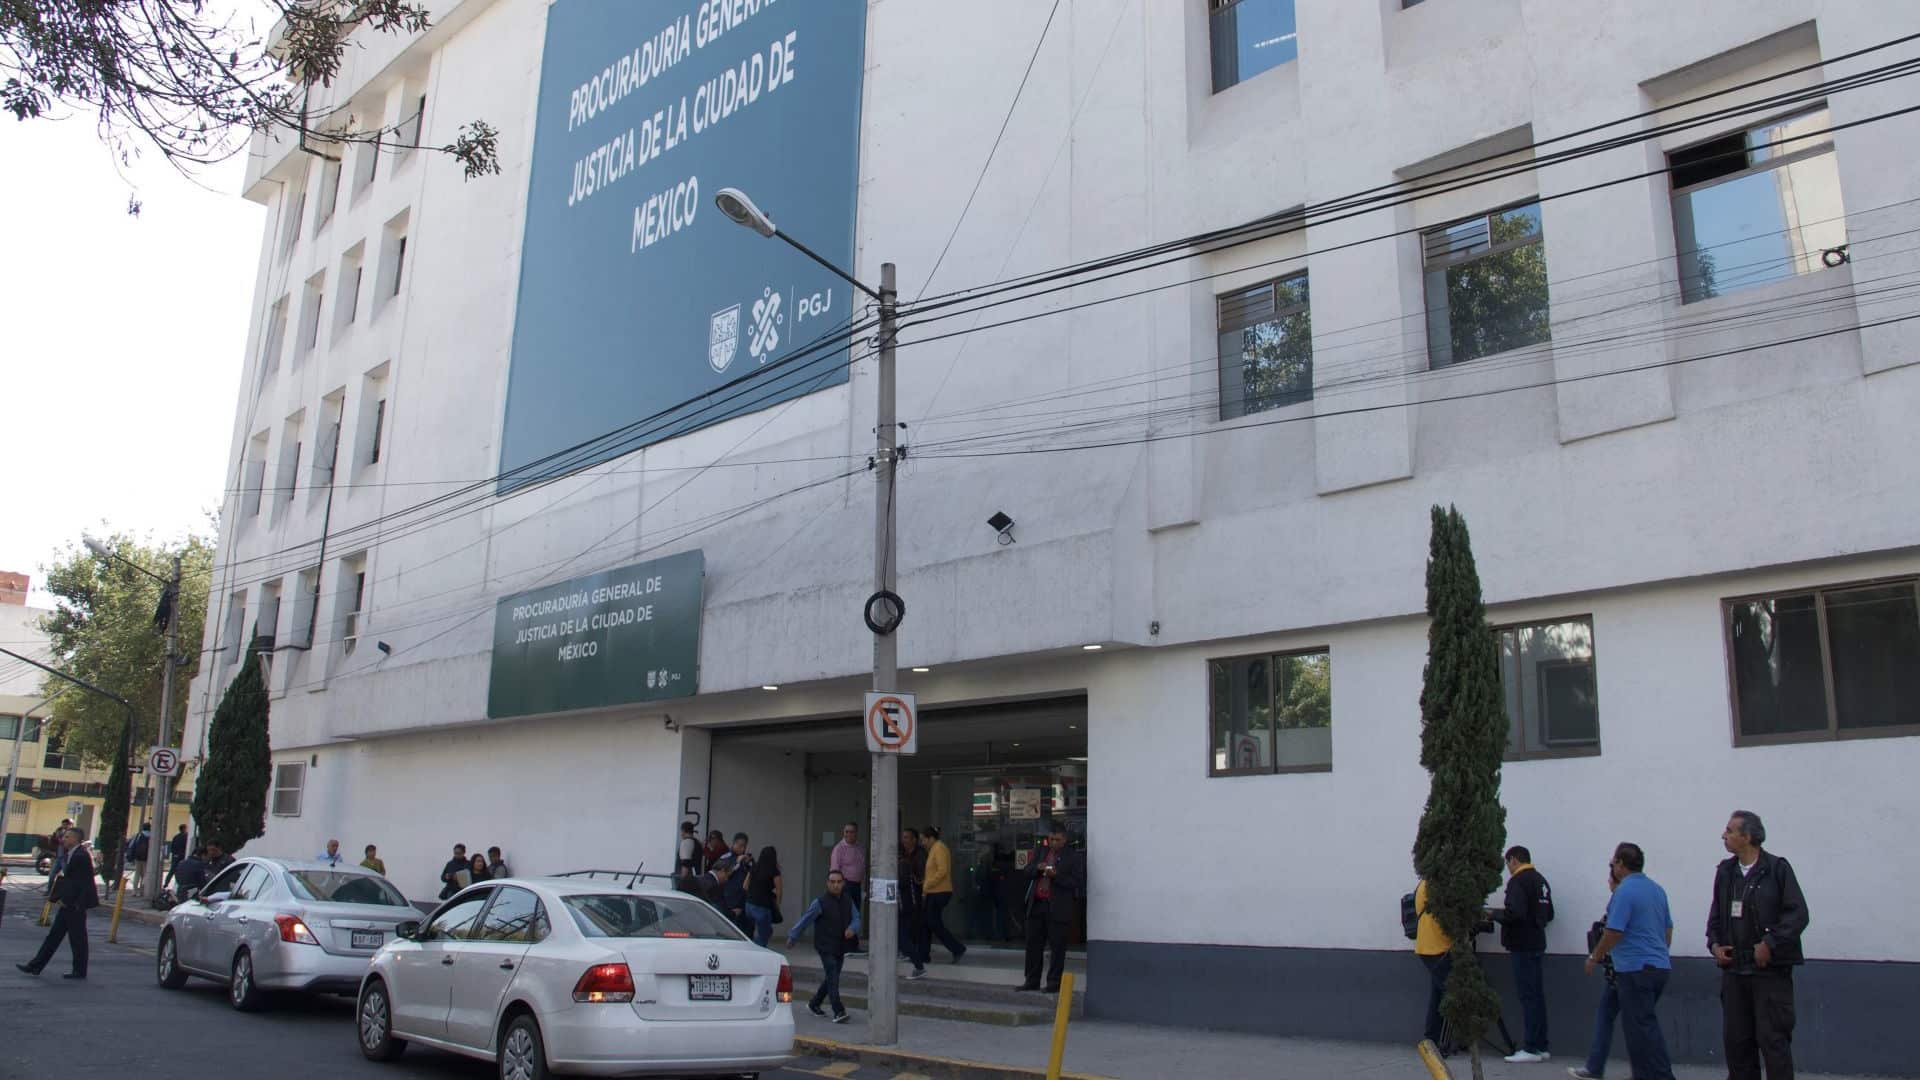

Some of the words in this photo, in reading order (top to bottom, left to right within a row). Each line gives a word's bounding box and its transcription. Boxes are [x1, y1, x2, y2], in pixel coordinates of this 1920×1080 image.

[568, 14, 690, 132] PROCURADURÍA
[568, 128, 634, 207] JUSTICIA
[639, 109, 664, 166] DE
[665, 97, 688, 151] LA
[693, 52, 763, 134] CIUDAD
[768, 30, 797, 93] DE
[798, 289, 832, 322] PGJ
[512, 589, 590, 621] PROCURADURÍA
[591, 580, 643, 603] GENERAL
[646, 576, 662, 593] DE
[515, 623, 558, 644] JUSTICIA
[560, 620, 574, 635] DE
[575, 617, 589, 633] LA
[591, 609, 634, 629] CIUDAD
[637, 605, 653, 623] DE
[558, 641, 598, 662] MÉXICO
[882, 707, 900, 738] E
